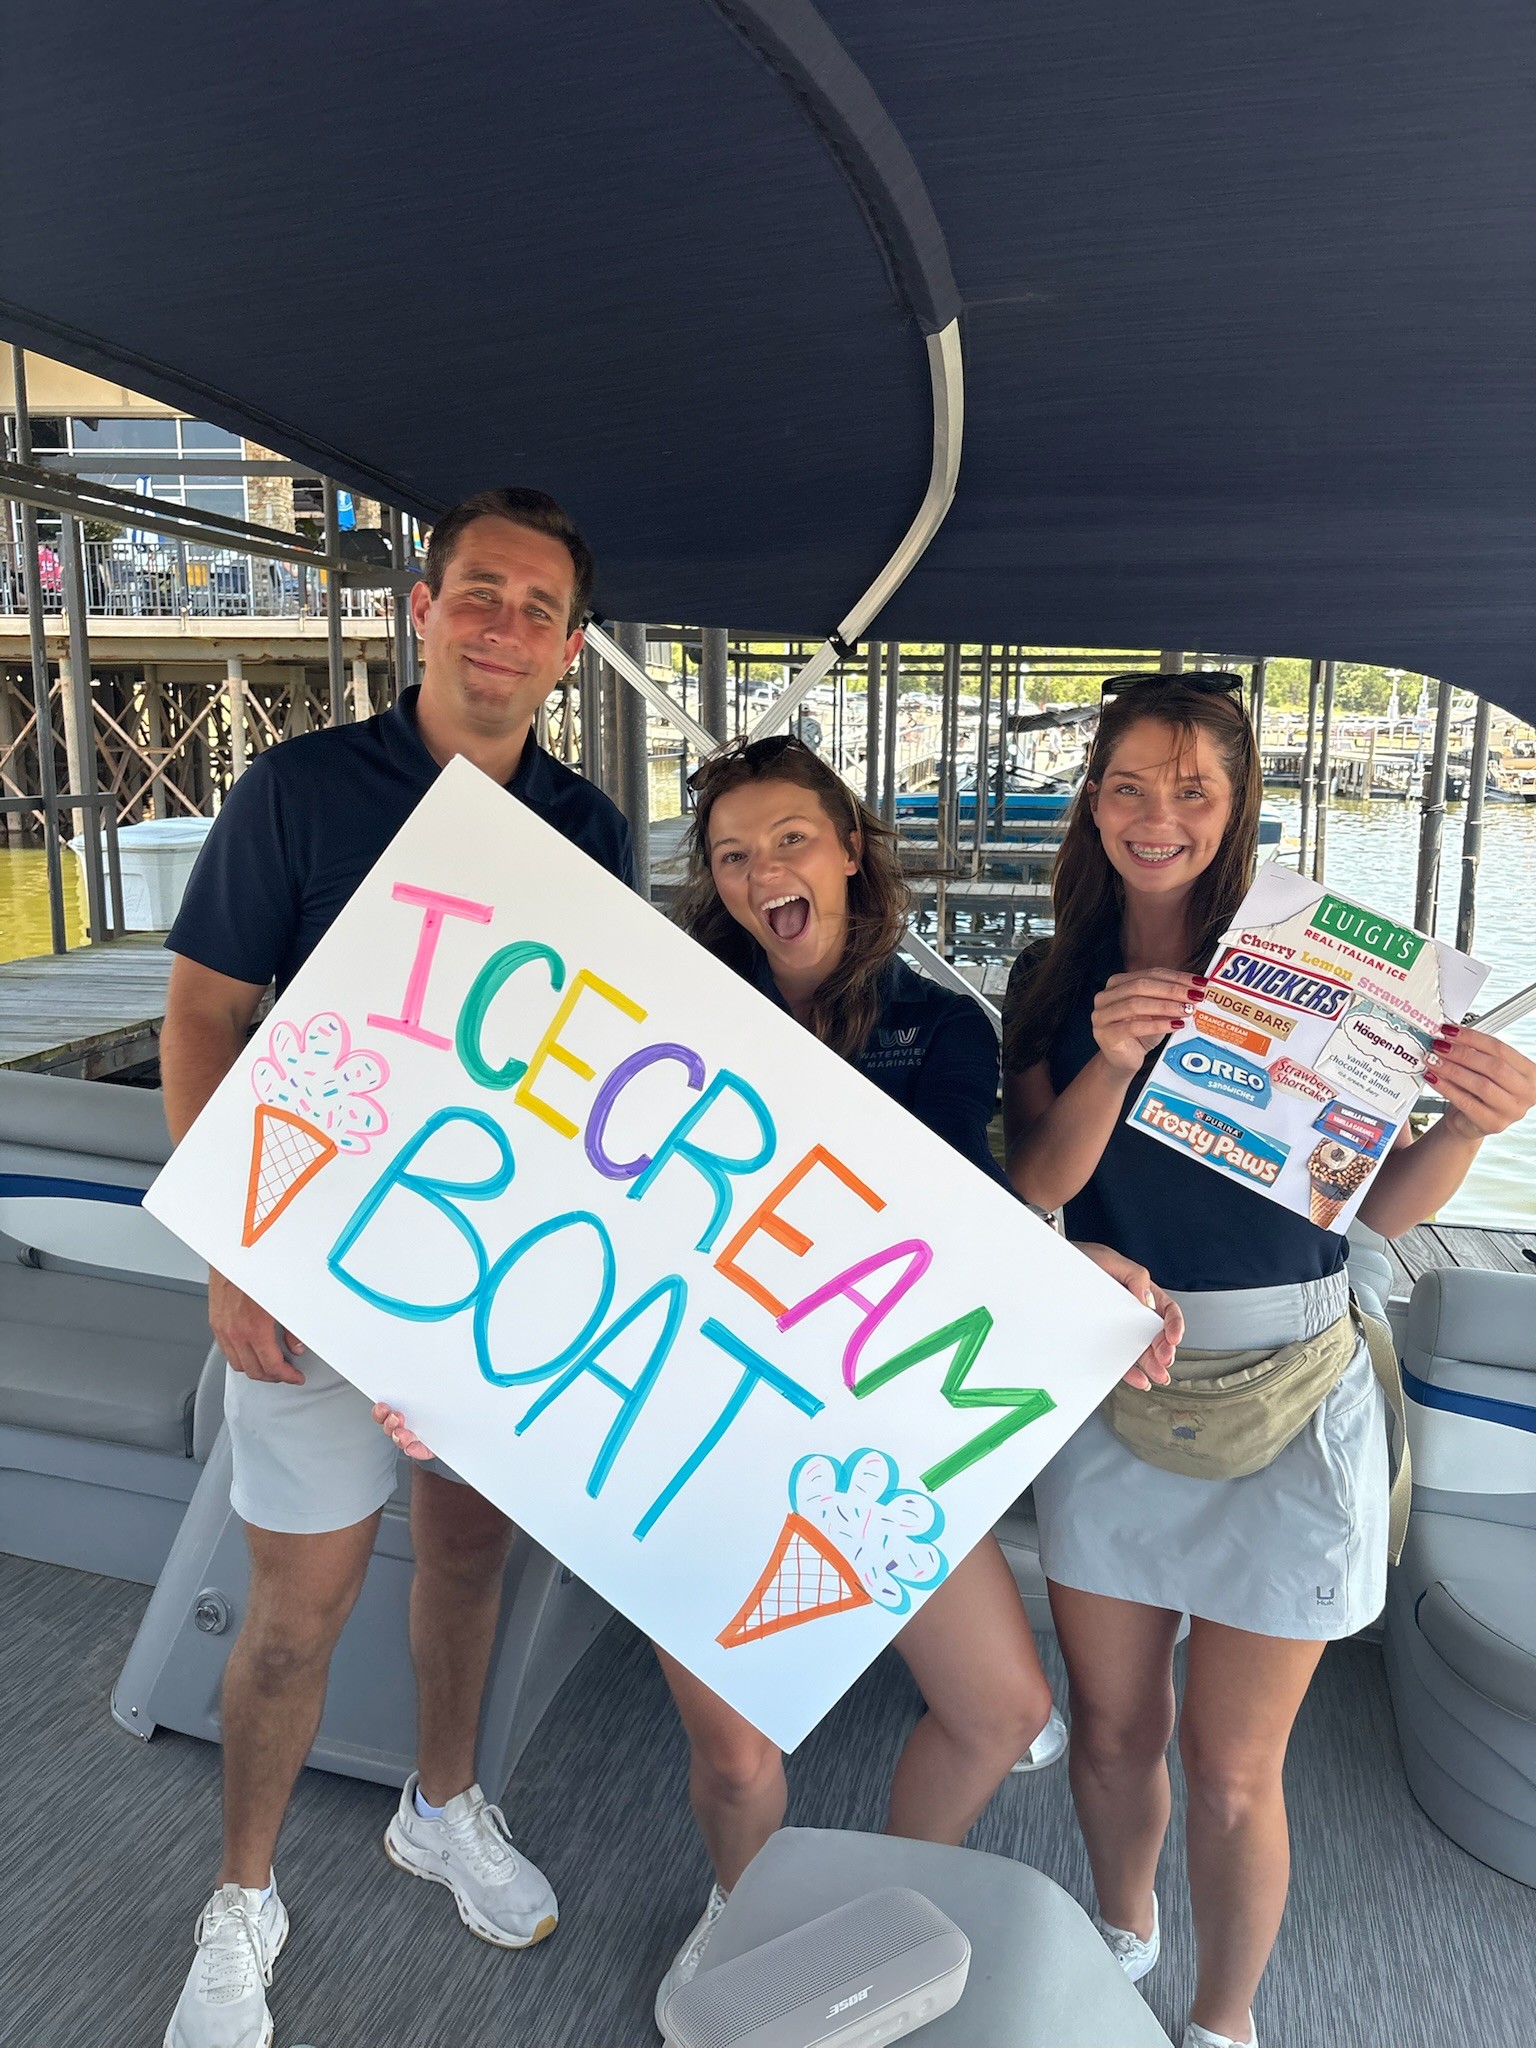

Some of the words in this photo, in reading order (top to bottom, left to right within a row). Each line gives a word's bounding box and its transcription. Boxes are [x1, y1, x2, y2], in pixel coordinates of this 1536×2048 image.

[1320, 903, 1415, 959] LUIGI'S
[1303, 928, 1334, 948] REAL
[1336, 943, 1385, 972] ITALIAN
[1386, 967, 1408, 982] ICE
[1220, 954, 1351, 1018] SNICKERS
[1240, 933, 1297, 960] Cherry
[1300, 951, 1354, 982] Lemon
[1357, 976, 1442, 1035] Strawberry
[1198, 1013, 1226, 1028] ORANGE
[1225, 1024, 1249, 1037] CREAM
[1204, 989, 1252, 1017] FUDGE
[1253, 1010, 1293, 1033] BARS
[866, 1058, 922, 1069] MARINAS
[1181, 1052, 1265, 1091] OREO
[1277, 1059, 1338, 1101] Strawberry
[1329, 1054, 1368, 1081] chocolate
[1367, 1078, 1401, 1100] almond
[1347, 1054, 1373, 1073] vanilla
[1374, 1069, 1392, 1085] milk
[1273, 1073, 1327, 1103] Shortcake
[1141, 1098, 1216, 1155] Frosty
[1212, 1136, 1279, 1183] Paws
[1204, 1115, 1240, 1137] PURINA
[326, 1106, 826, 1542] BOAT
[826, 1984, 874, 2019] BOSE
